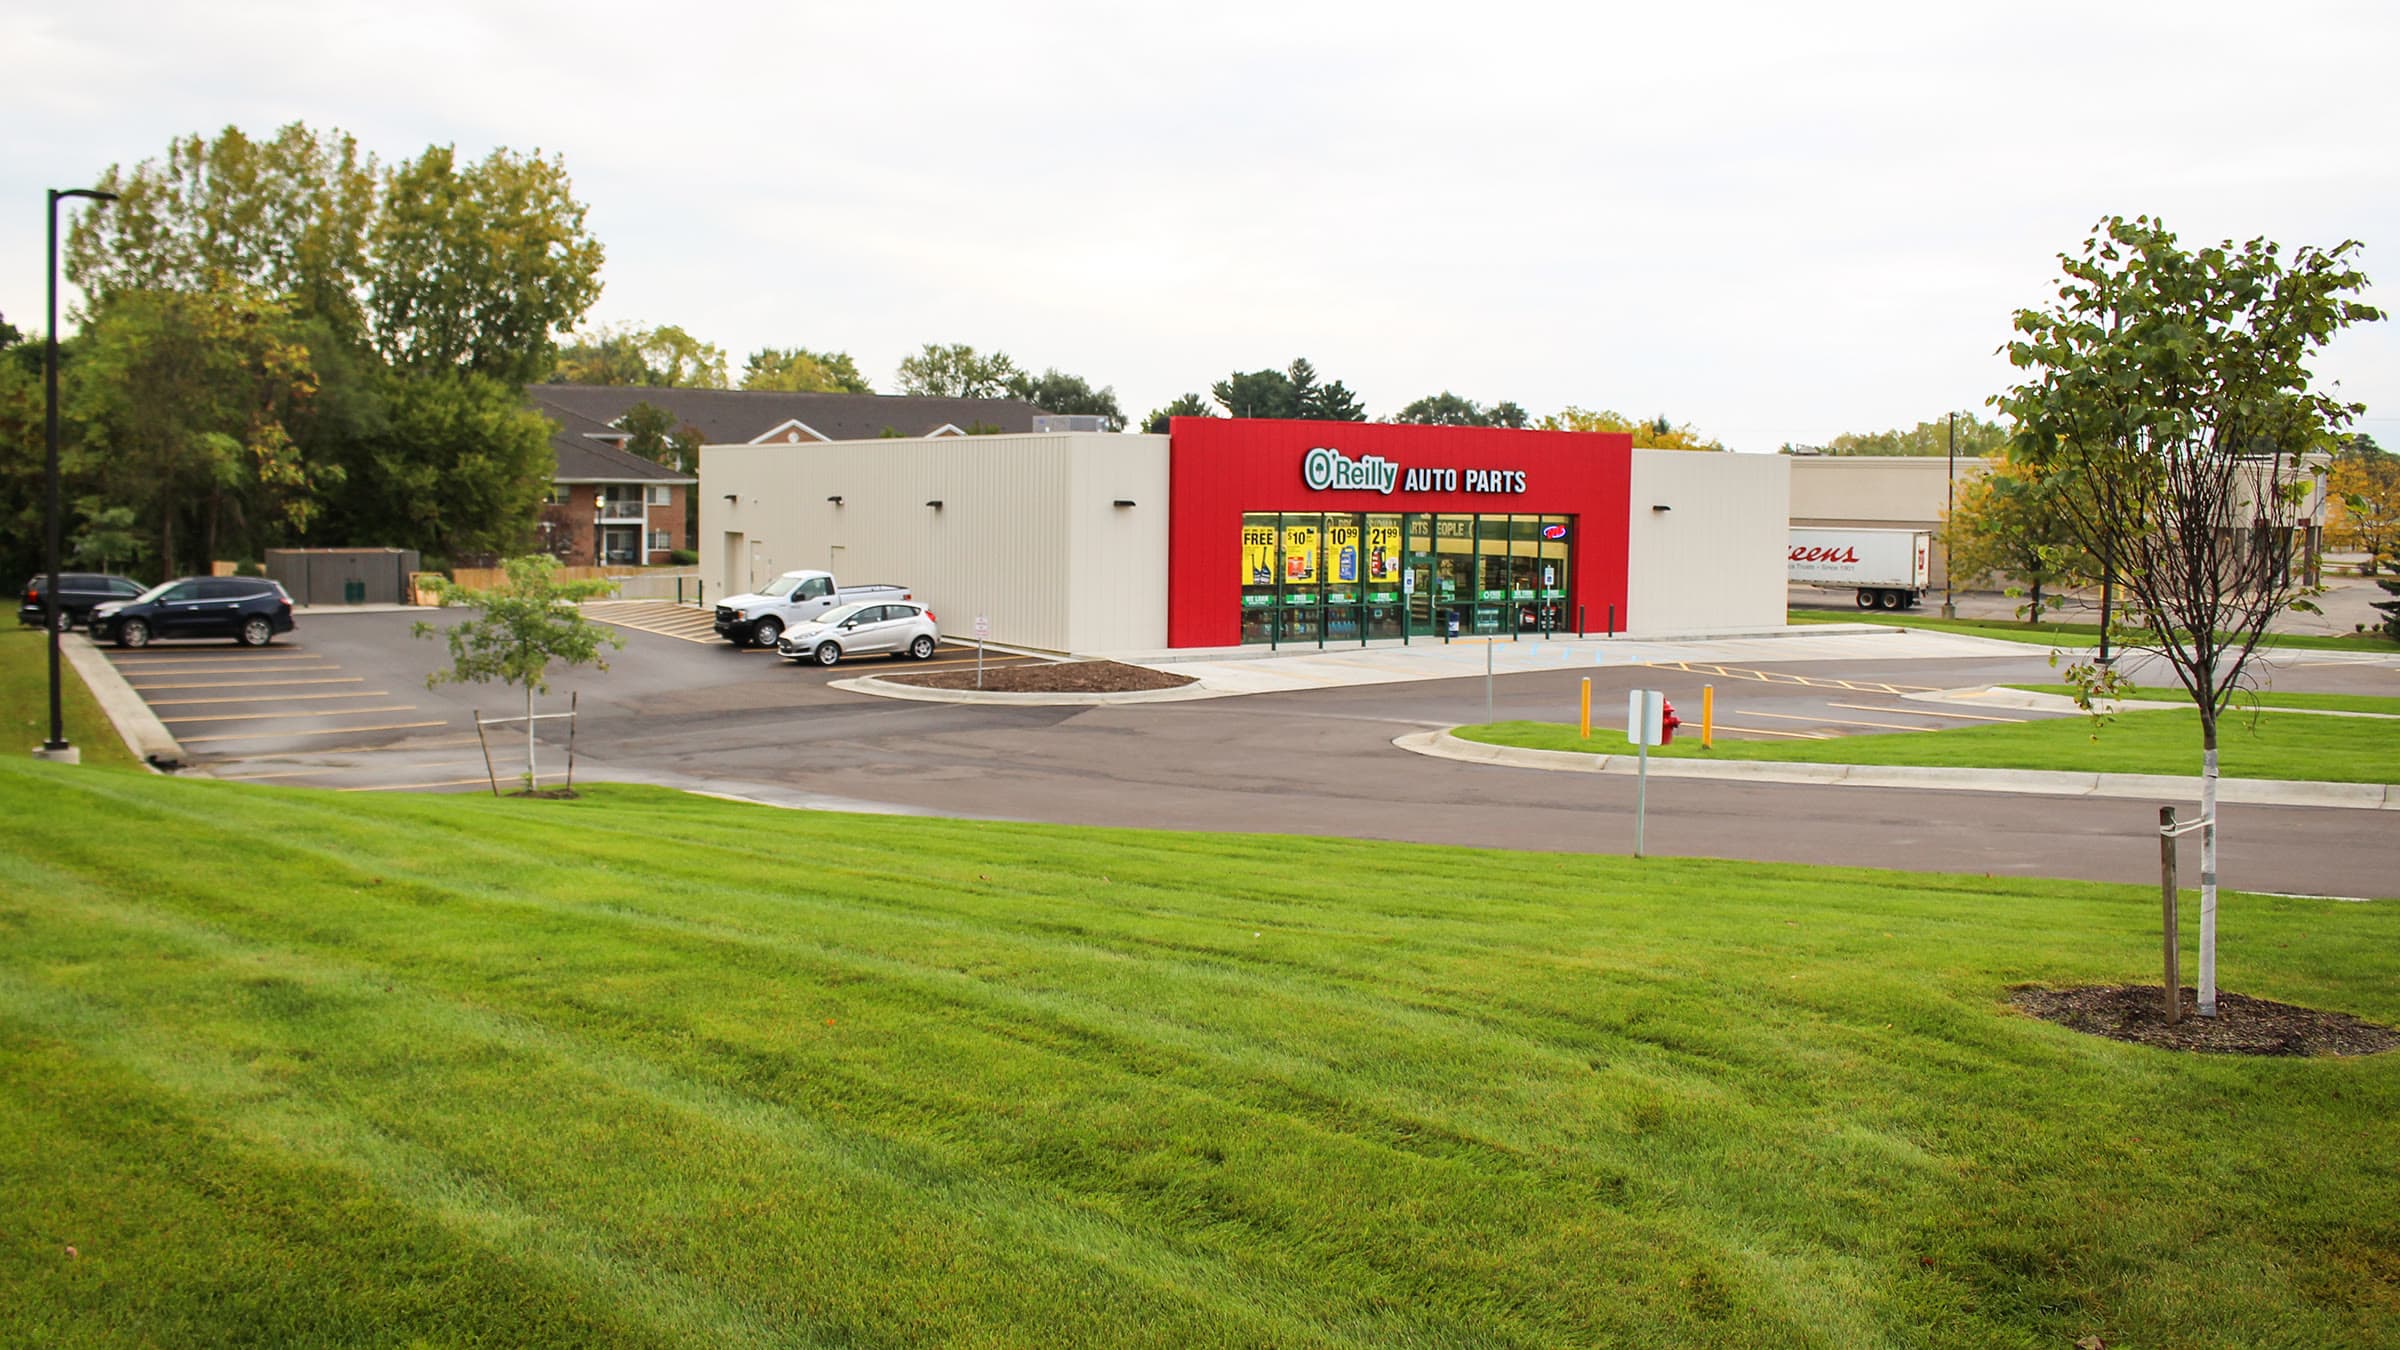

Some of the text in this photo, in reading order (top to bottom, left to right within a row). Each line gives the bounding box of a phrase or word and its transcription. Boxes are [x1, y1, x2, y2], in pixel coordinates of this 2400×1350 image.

[1306, 449, 1527, 493] O'Reilly AUTO PARTS
[1437, 522, 1465, 536] EOPLE
[1243, 532, 1273, 545] FREE
[1788, 546, 1860, 563] eens
